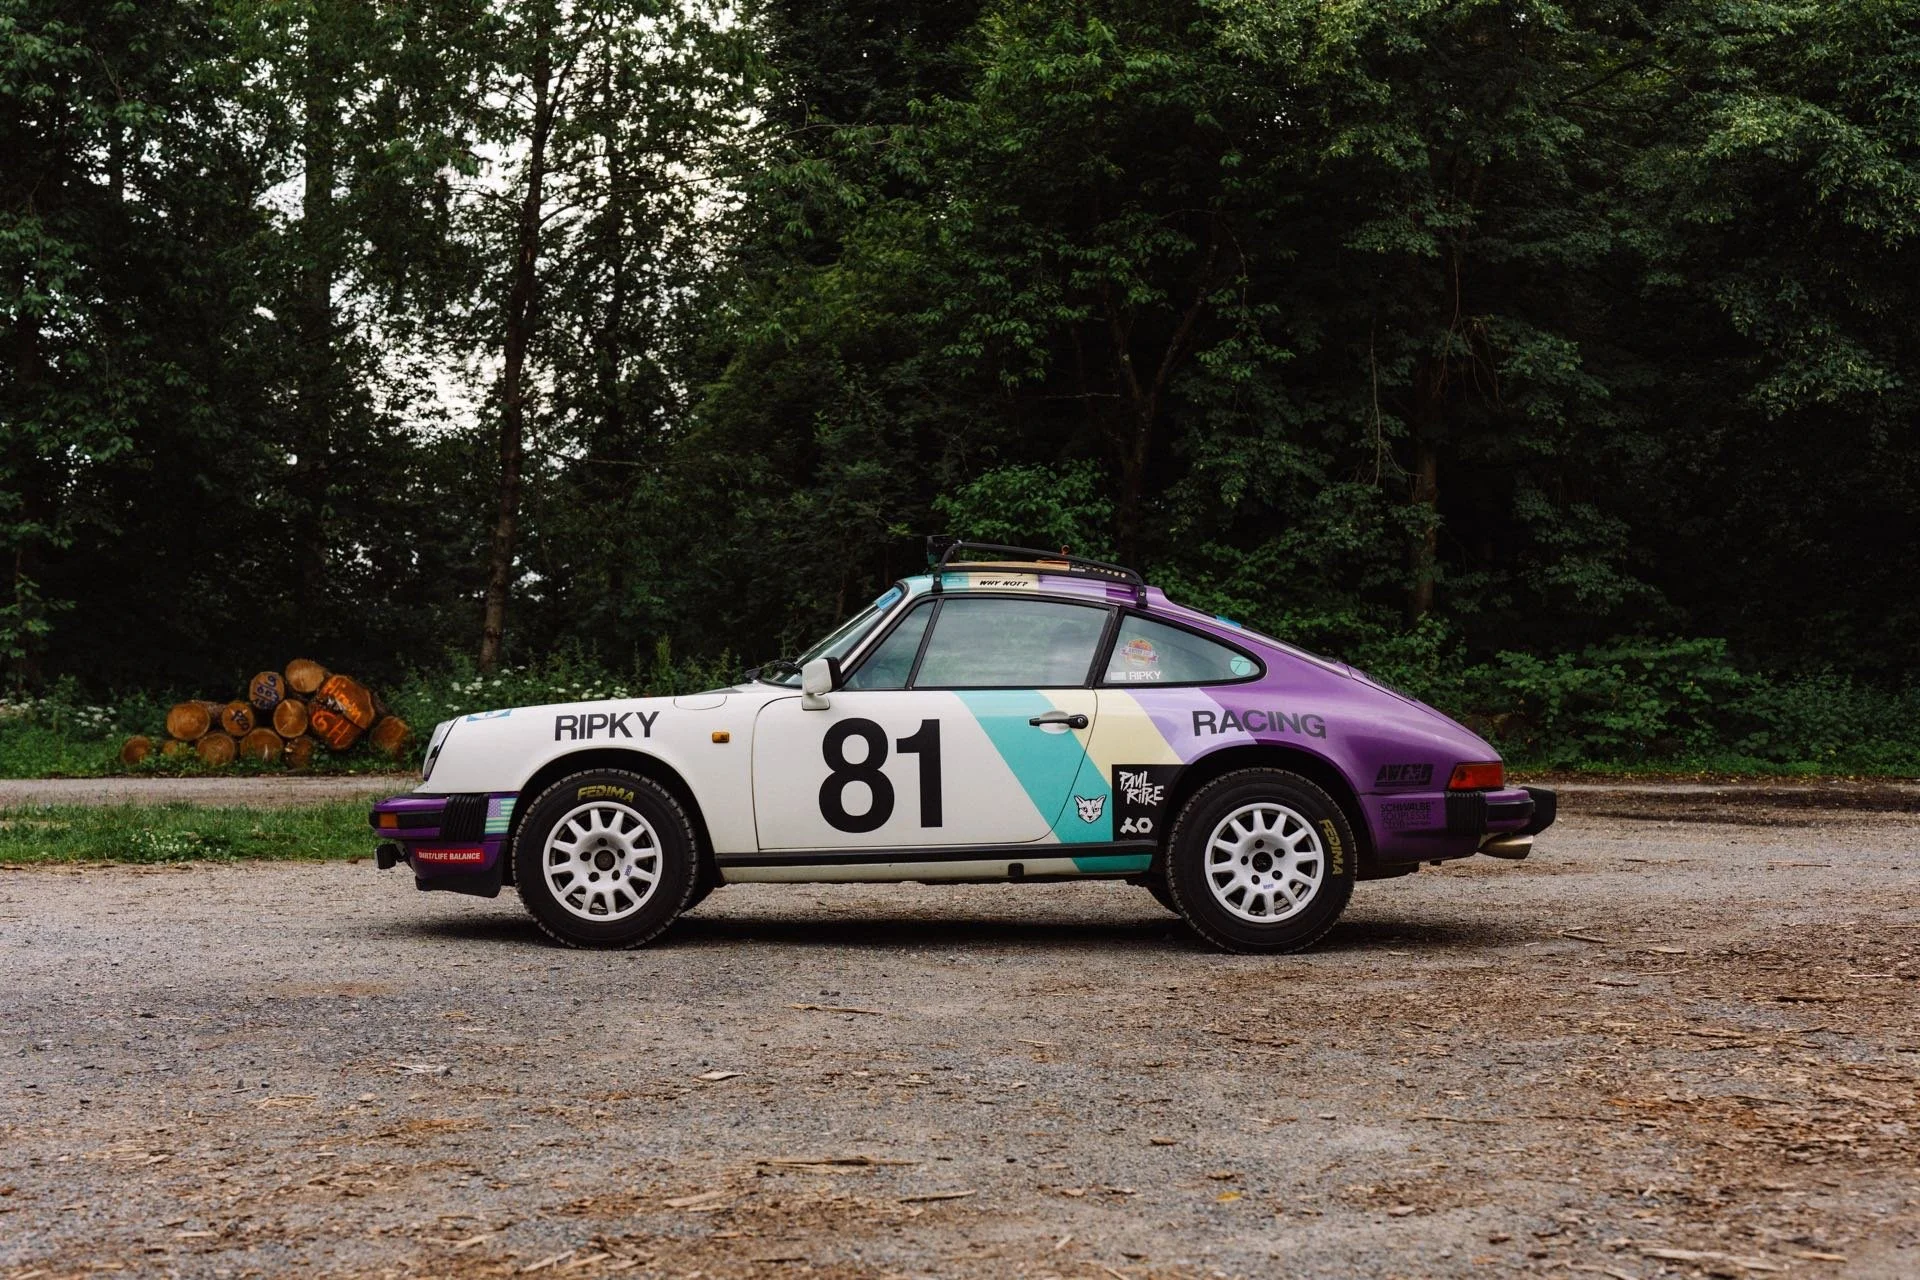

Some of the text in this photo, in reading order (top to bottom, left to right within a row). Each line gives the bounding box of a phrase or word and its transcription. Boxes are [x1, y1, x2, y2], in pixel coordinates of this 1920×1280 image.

[1129, 671, 1161, 680] RIPKY
[554, 711, 660, 741] RIPKY
[1192, 709, 1327, 739] RACING
[818, 717, 943, 833] 81
[1119, 770, 1153, 791] PAUL
[577, 784, 635, 803] FEDIMA
[1380, 801, 1431, 812] SCHWALBE
[418, 851, 481, 860] DIRT/LIFE BALANCE
[1318, 819, 1344, 875] FEDIMA
